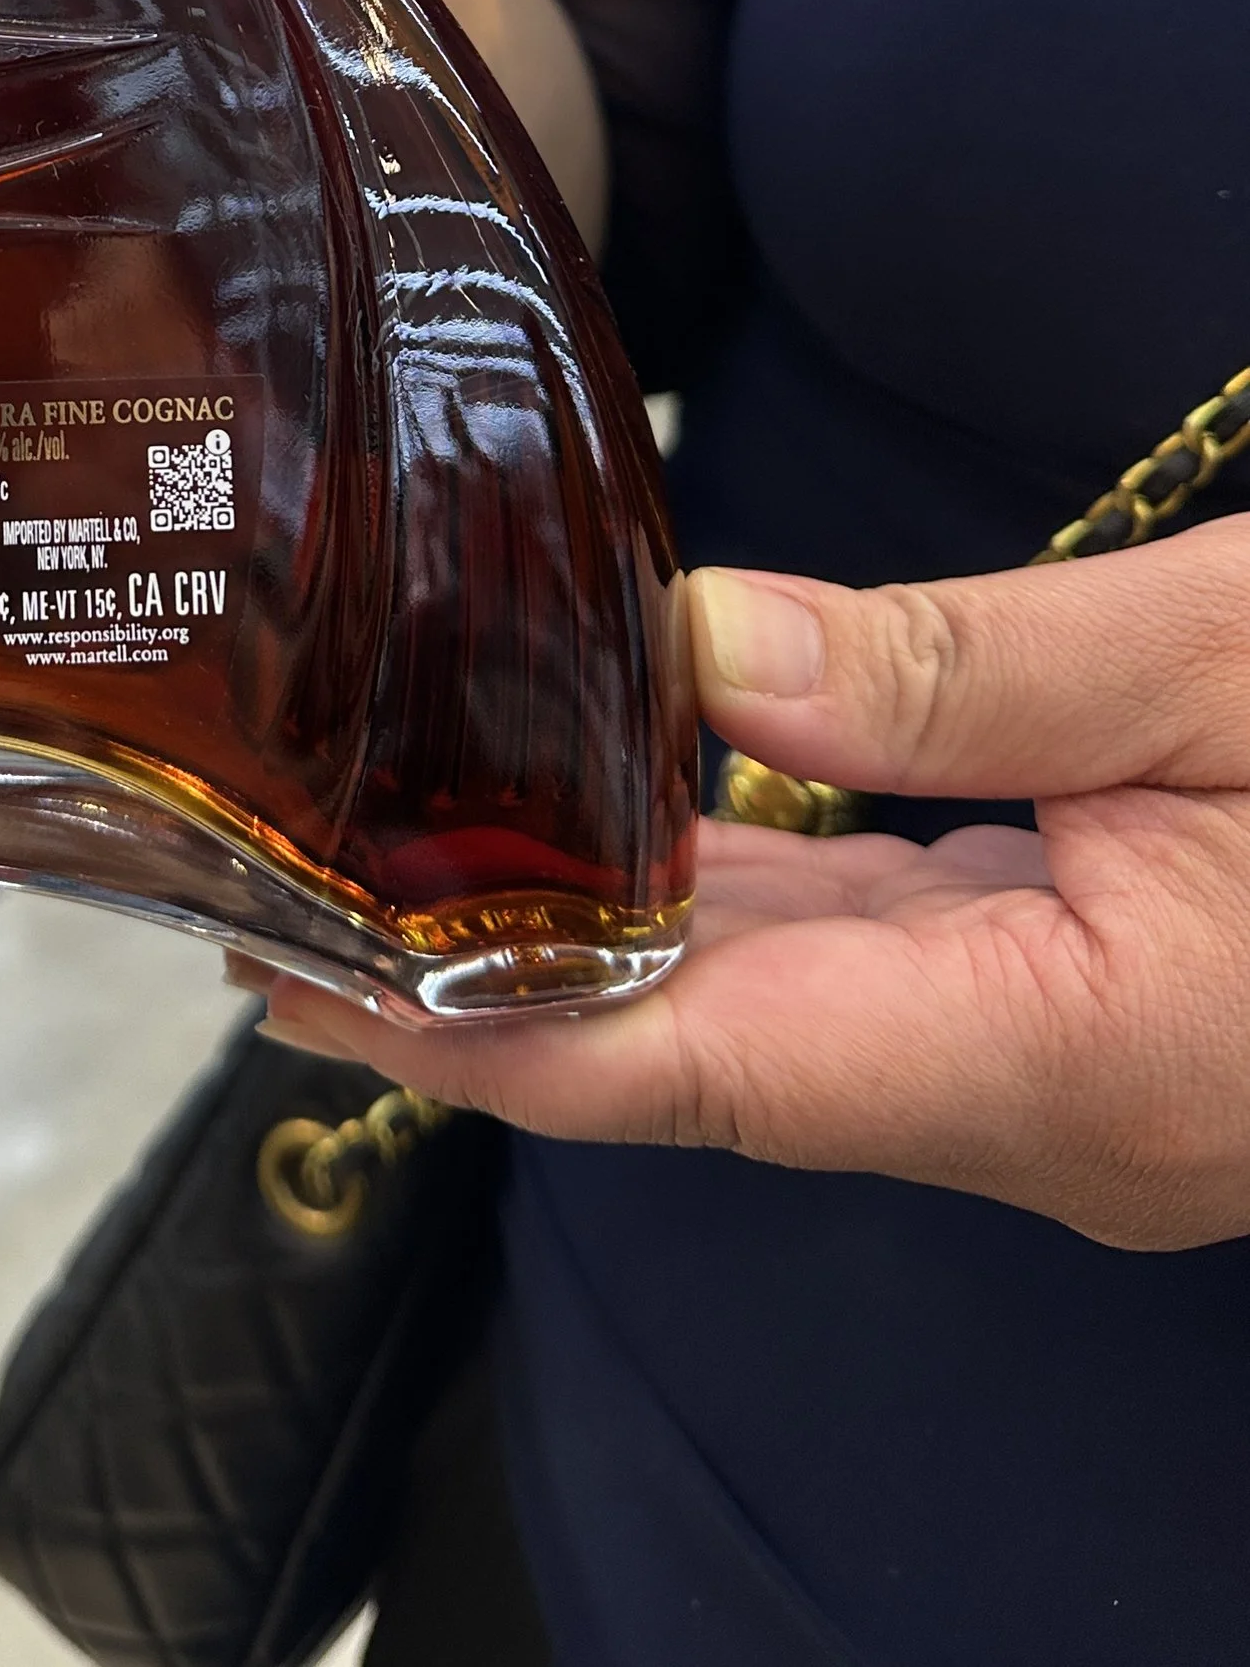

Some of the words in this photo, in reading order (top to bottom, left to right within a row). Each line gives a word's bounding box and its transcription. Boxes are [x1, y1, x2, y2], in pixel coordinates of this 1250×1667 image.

[42, 399, 106, 426] FINE
[112, 396, 235, 423] COGNAC
[11, 429, 70, 462] alc./vol.
[3, 519, 51, 545] IMPORTED
[53, 519, 66, 543] BY
[68, 517, 112, 542] MARTELL
[113, 517, 122, 542] &
[123, 516, 140, 545] CO,
[37, 546, 59, 570] NEW
[61, 545, 90, 573] YORK,
[91, 544, 108, 569] NY.
[22, 589, 77, 621] ME-VT
[128, 572, 164, 617] CA
[174, 570, 226, 616] CRV
[3, 624, 190, 648] www.responsibility.org
[25, 645, 168, 666] www.martell.com
